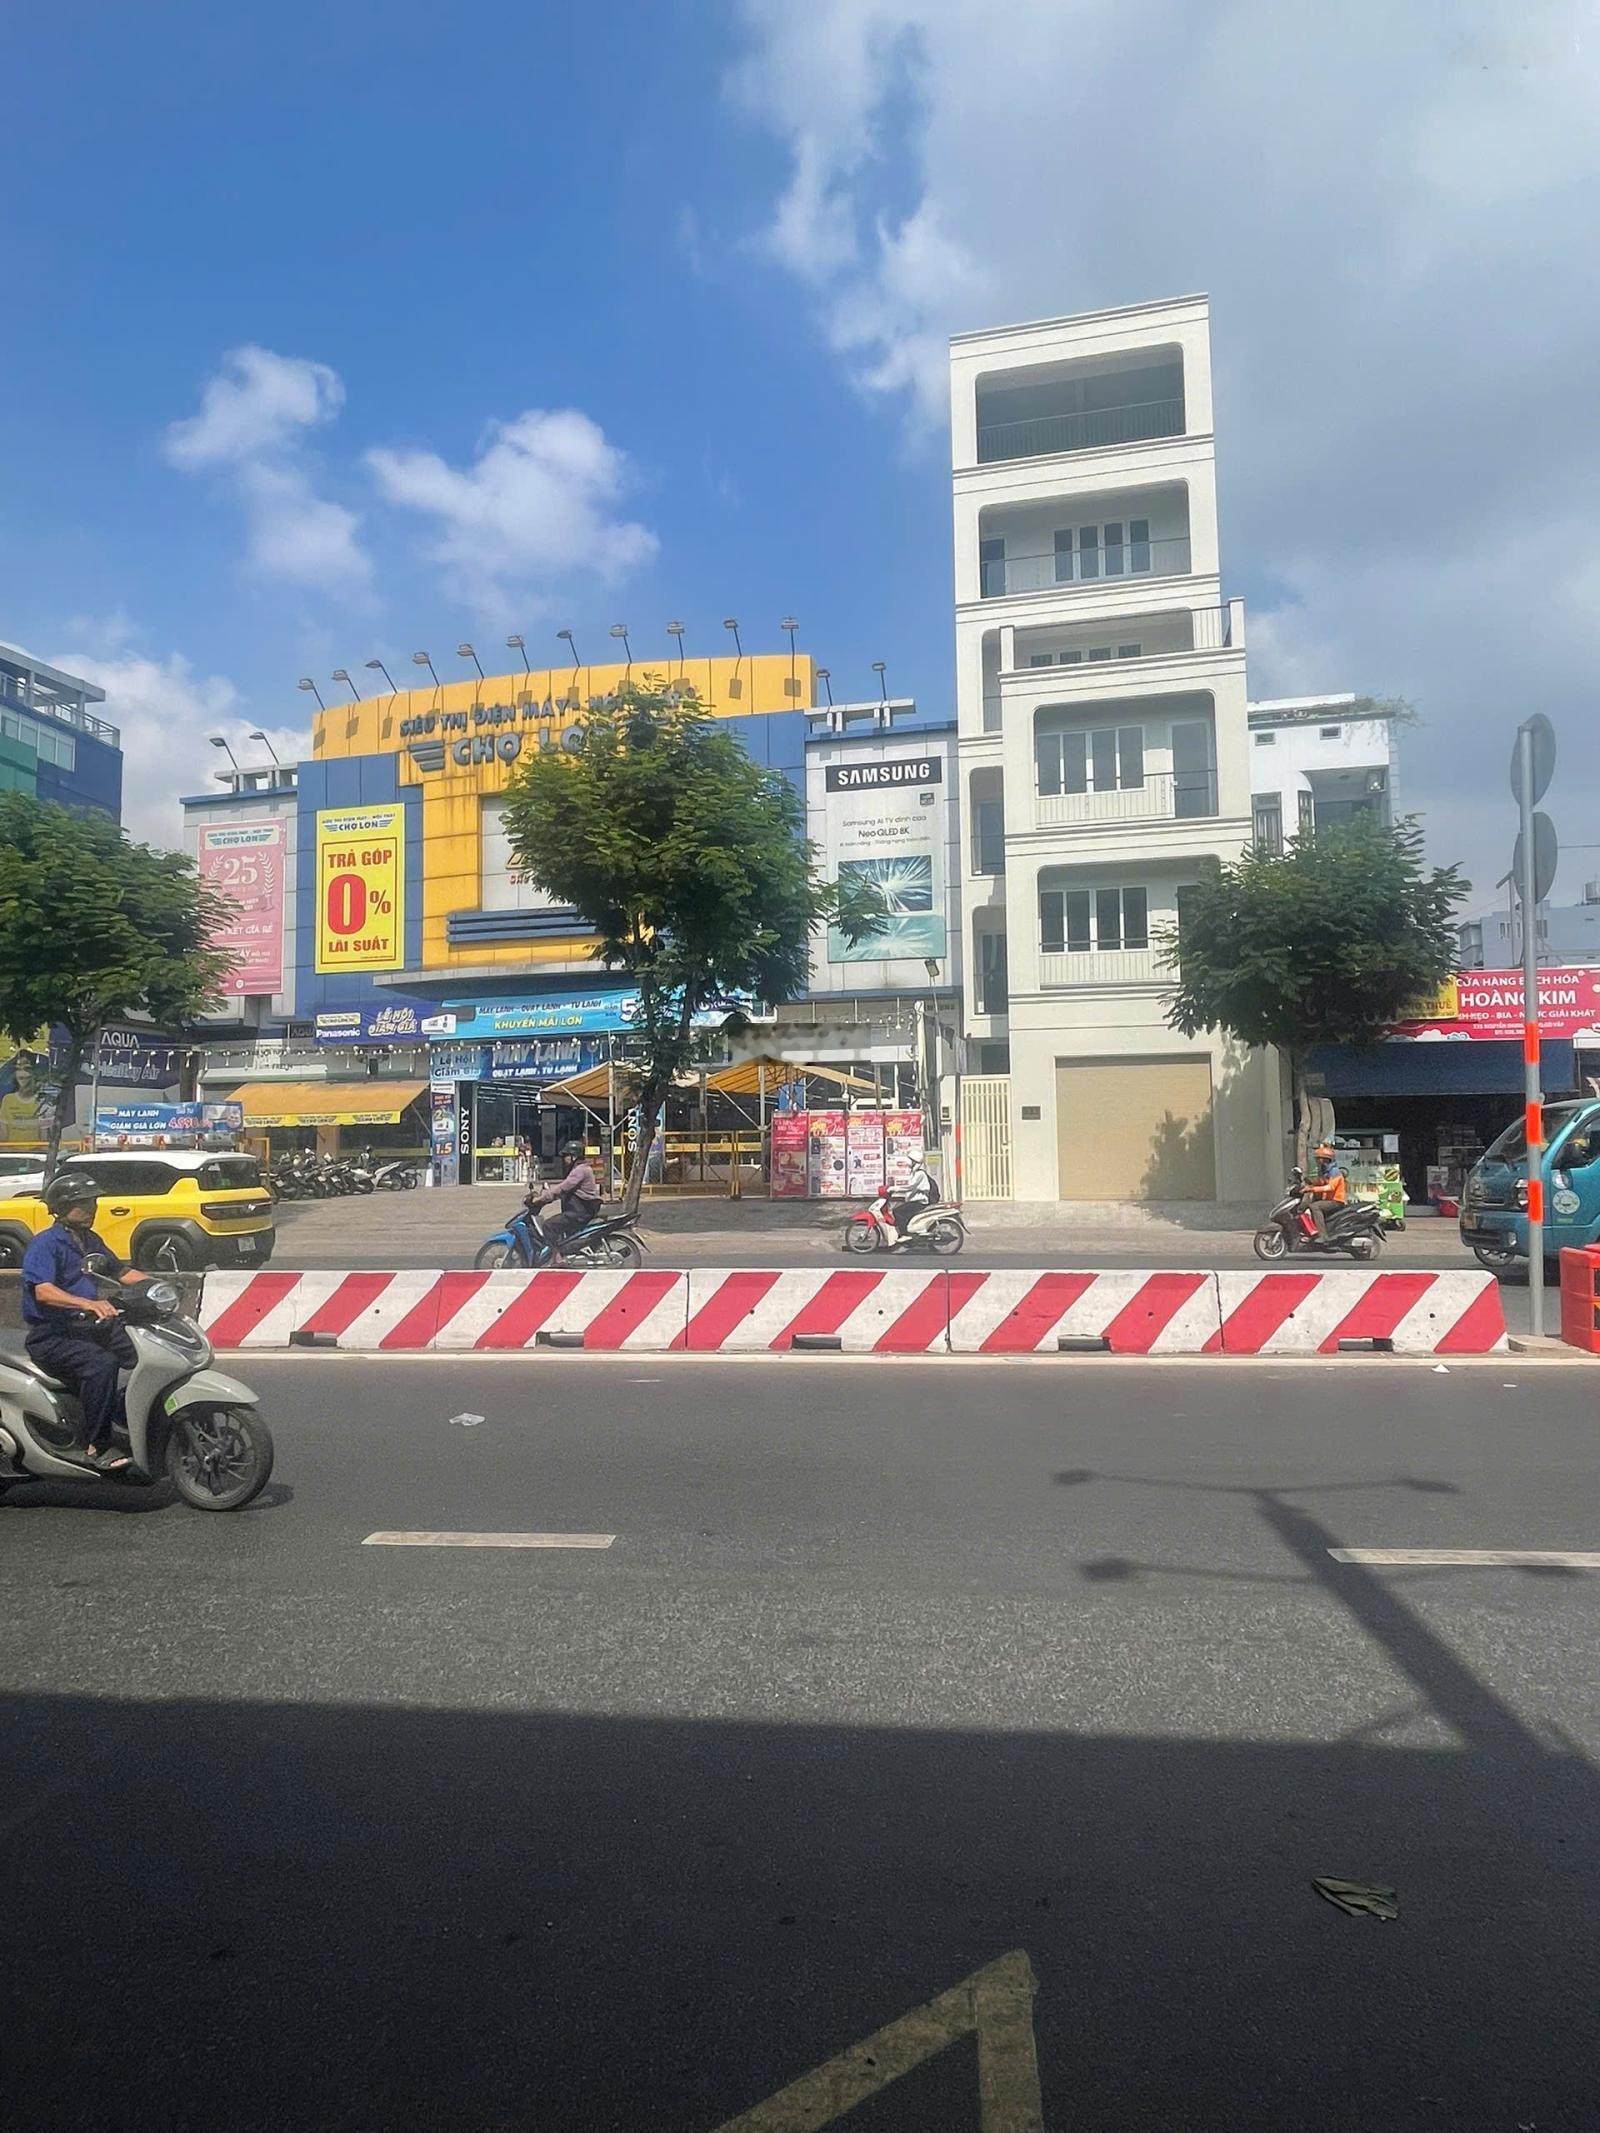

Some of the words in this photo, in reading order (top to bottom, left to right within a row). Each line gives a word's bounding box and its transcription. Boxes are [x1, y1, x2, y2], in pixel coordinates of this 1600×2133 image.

[441, 711, 468, 733] THỊ
[474, 702, 516, 728] ĐIỆN
[453, 730, 524, 767] CHỢ
[838, 763, 930, 786] SAMSUNG
[842, 818, 876, 827] Samsung
[858, 830, 876, 838] Neo
[877, 828, 899, 837] QLED
[900, 826, 910, 835] 8K
[328, 849, 357, 868] TRẢ
[361, 848, 392, 867] GÓP
[223, 856, 258, 886] 25
[1482, 974, 1517, 986] HÀNG
[1553, 973, 1580, 984] HÓA
[1538, 990, 1577, 1005] KIM
[494, 1015, 536, 1030] KHUYẾN
[561, 1014, 583, 1026] LỚN
[1496, 1011, 1512, 1020] BIA
[1570, 1008, 1596, 1018] KHÁT
[101, 1031, 140, 1048] AQUA
[316, 1028, 360, 1038] Panasonic
[460, 1107, 470, 1154] SONY
